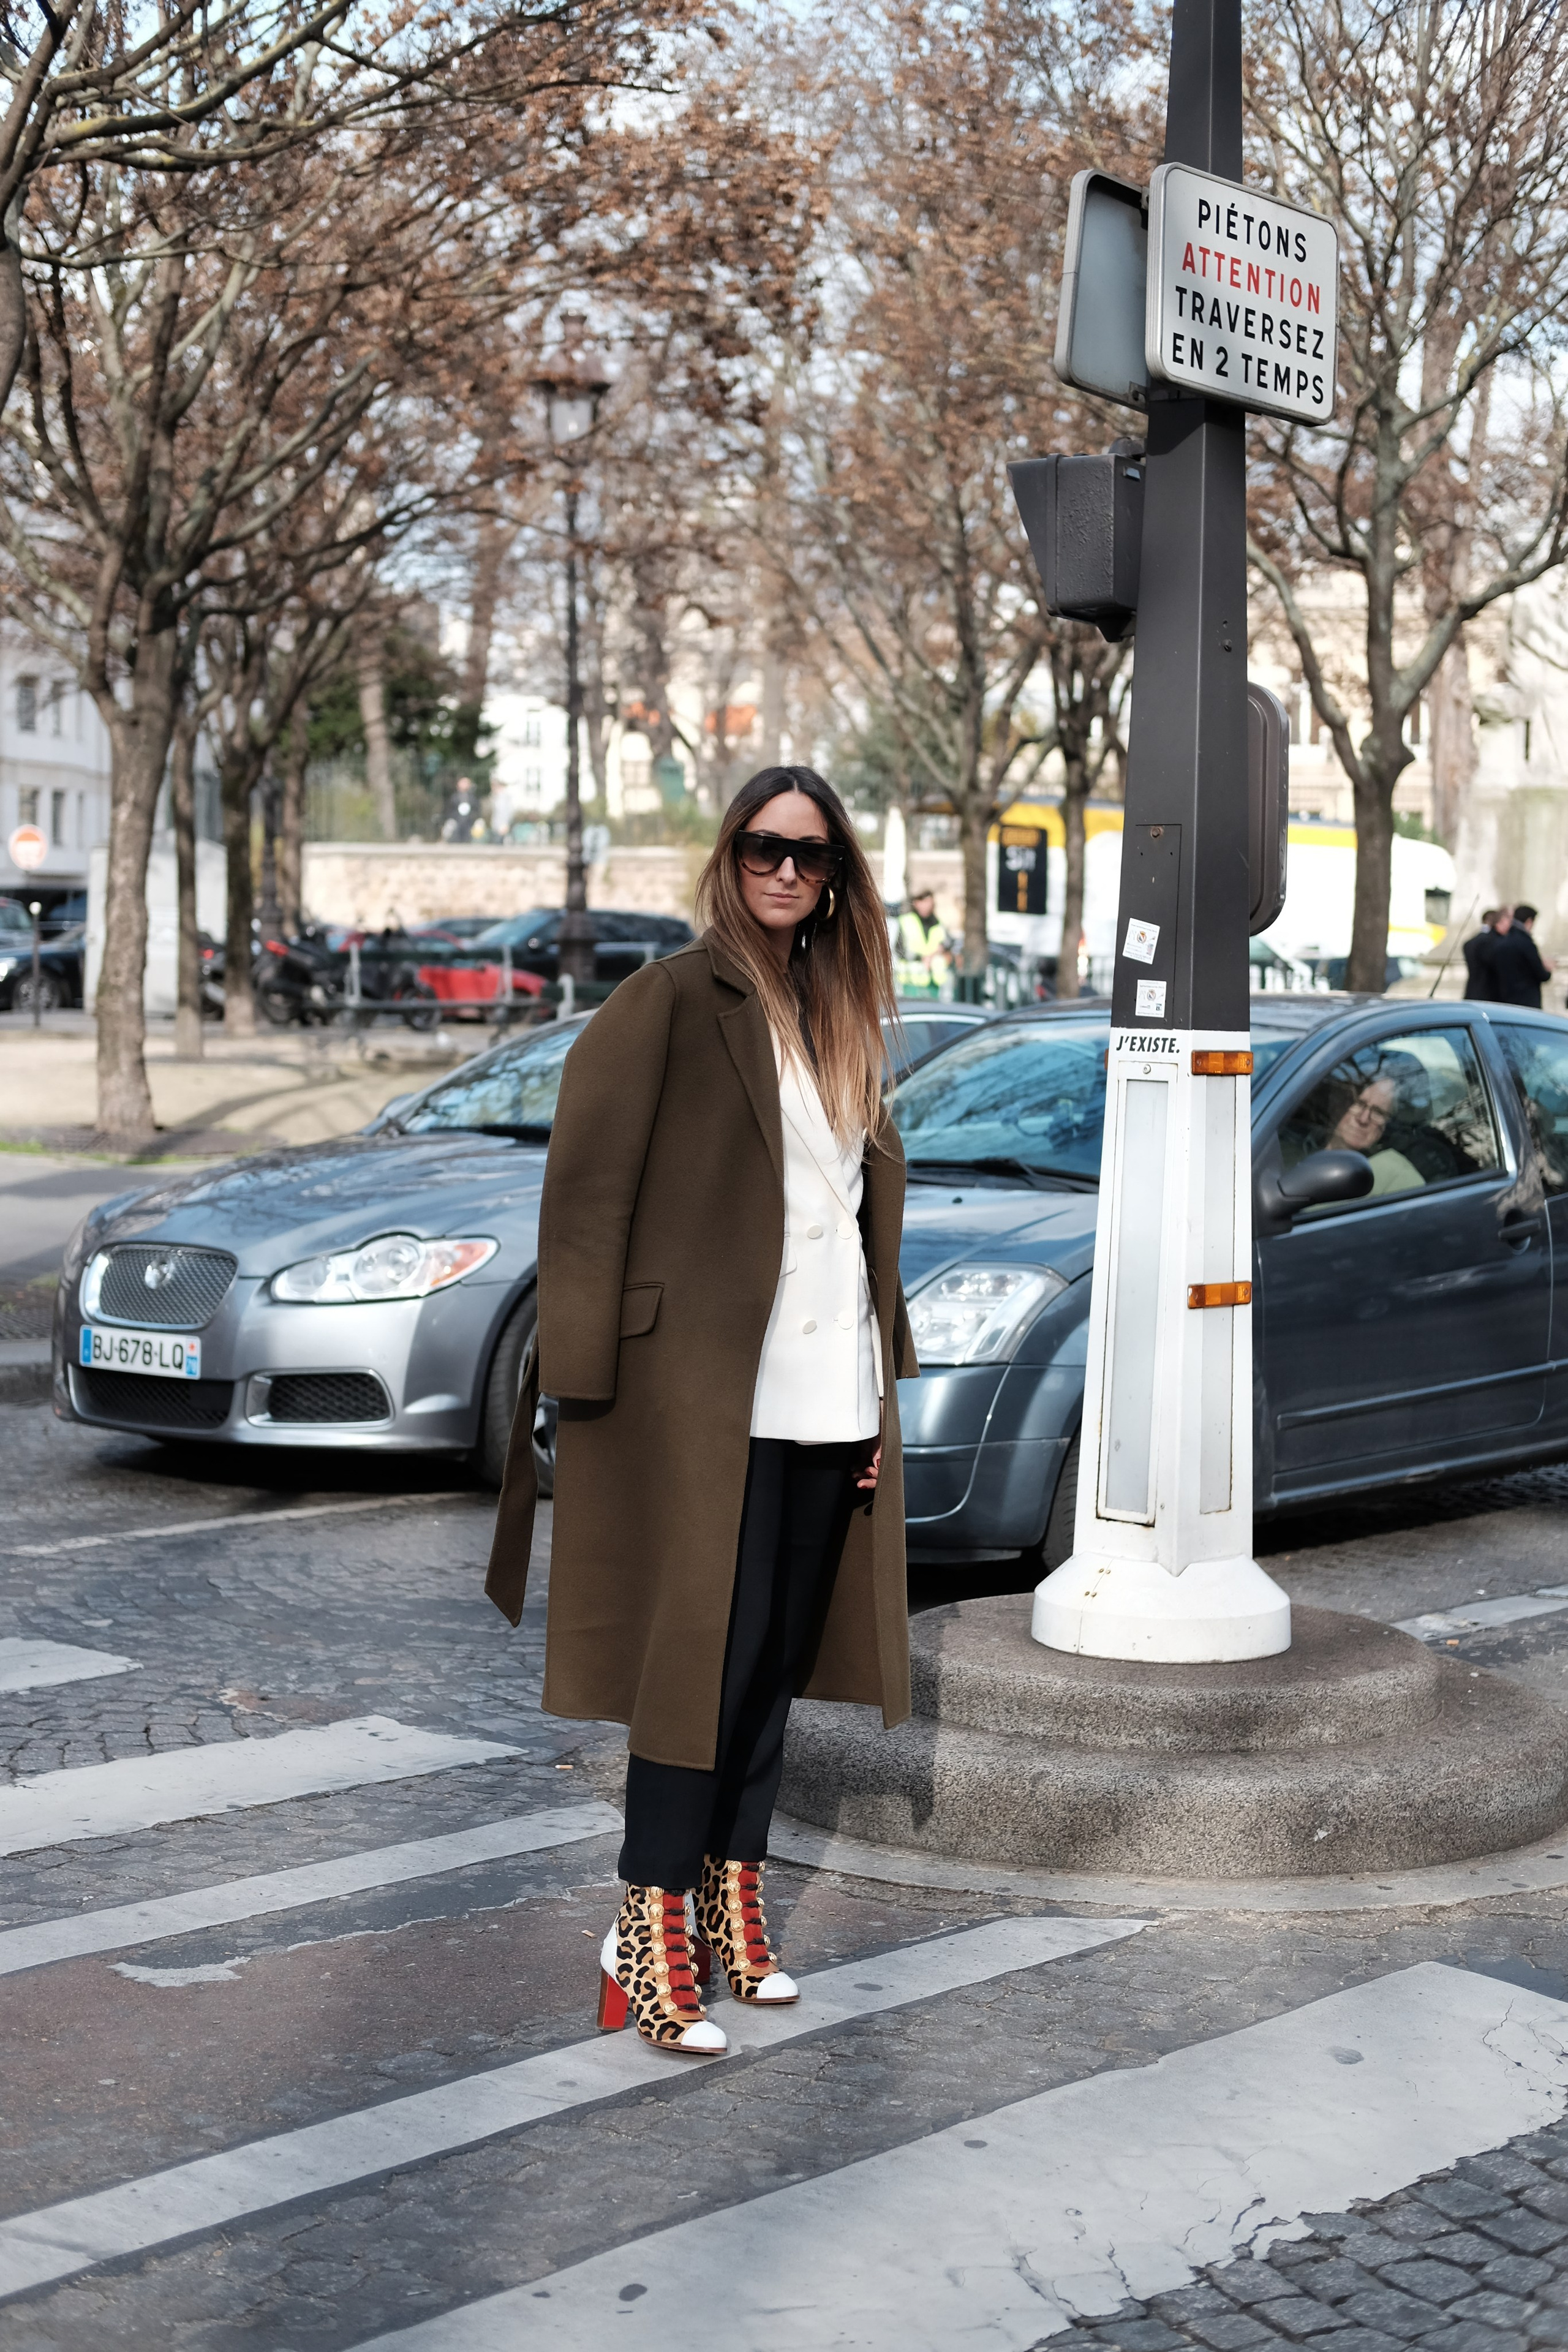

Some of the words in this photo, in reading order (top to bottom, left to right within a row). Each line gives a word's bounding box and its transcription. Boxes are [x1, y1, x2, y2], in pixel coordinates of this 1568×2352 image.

[1198, 198, 1306, 262] PIÉTONS
[1182, 242, 1320, 314] ATTENTION
[1175, 285, 1324, 360] TRAVERSEZ
[1172, 332, 1204, 371] EN
[1216, 346, 1229, 378] 2
[1241, 353, 1324, 404] TEMPS
